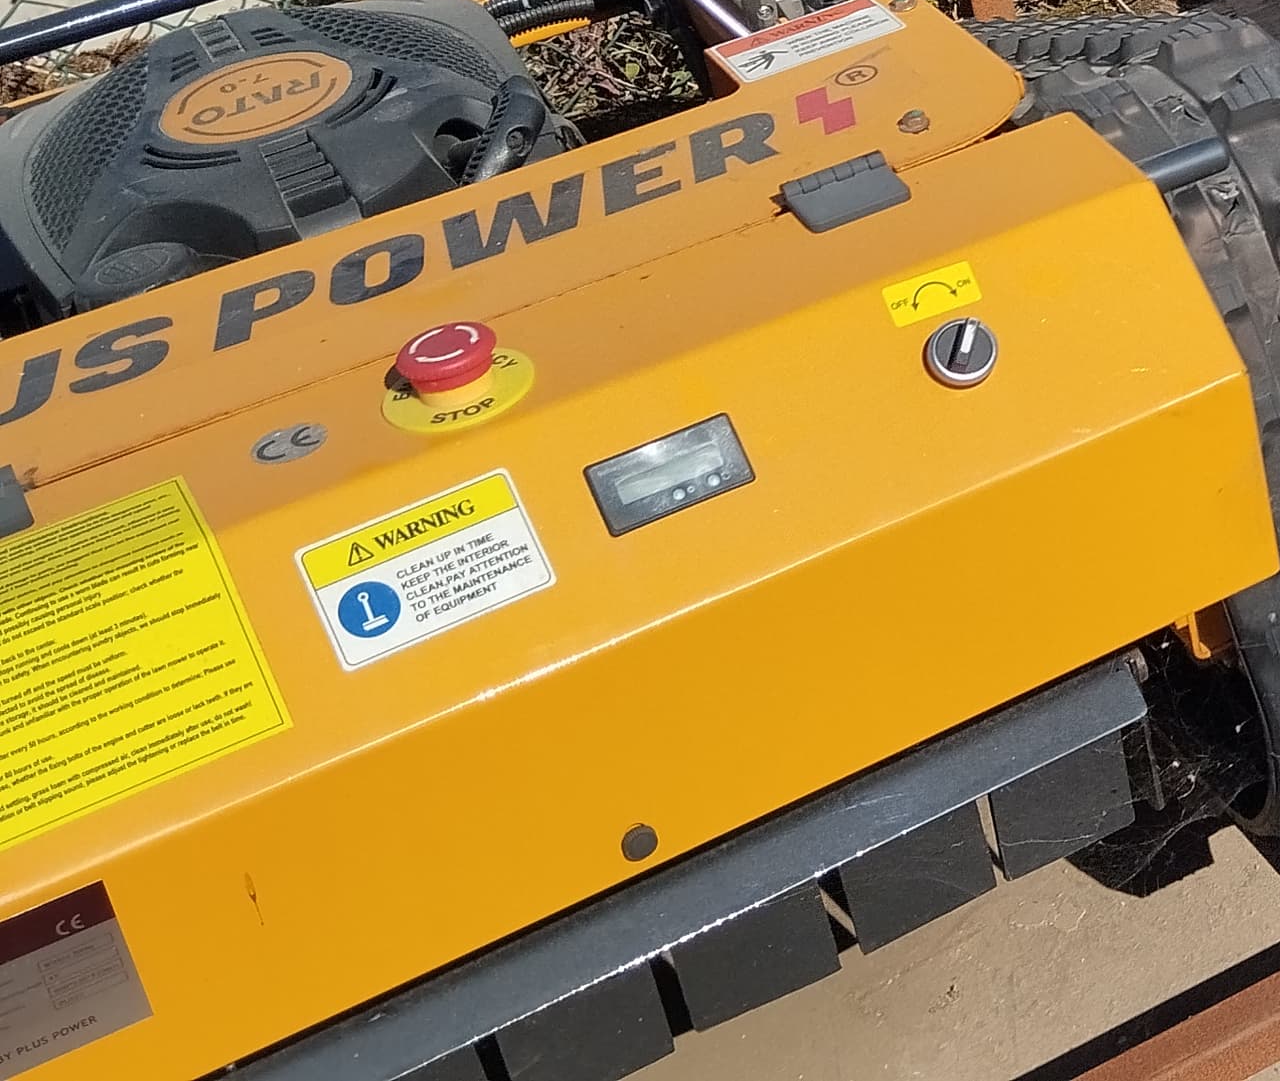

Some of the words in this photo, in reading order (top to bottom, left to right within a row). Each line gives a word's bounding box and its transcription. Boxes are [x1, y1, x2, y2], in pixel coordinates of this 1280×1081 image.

[192, 71, 321, 126] RATO
[213, 113, 780, 351] POWER
[890, 296, 911, 312] OFF
[430, 397, 496, 424] STOP
[374, 499, 475, 549] WARNING
[396, 557, 434, 579] CLEAN
[436, 551, 451, 562] UP
[454, 544, 465, 555] IN
[468, 533, 494, 549] TIME
[401, 572, 431, 590] KEEP
[434, 562, 455, 577] THE
[457, 539, 510, 566] INTERIOR
[469, 544, 529, 575] ATTENTION
[410, 600, 427, 612] TO
[429, 589, 451, 604] THE
[453, 555, 533, 595] MAINTENANCE
[416, 610, 430, 623] OF
[433, 582, 498, 614] EQUIPMENT
[56, 913, 86, 937] CE
[16, 1037, 49, 1055] PLUS
[52, 1015, 98, 1040] POWER
